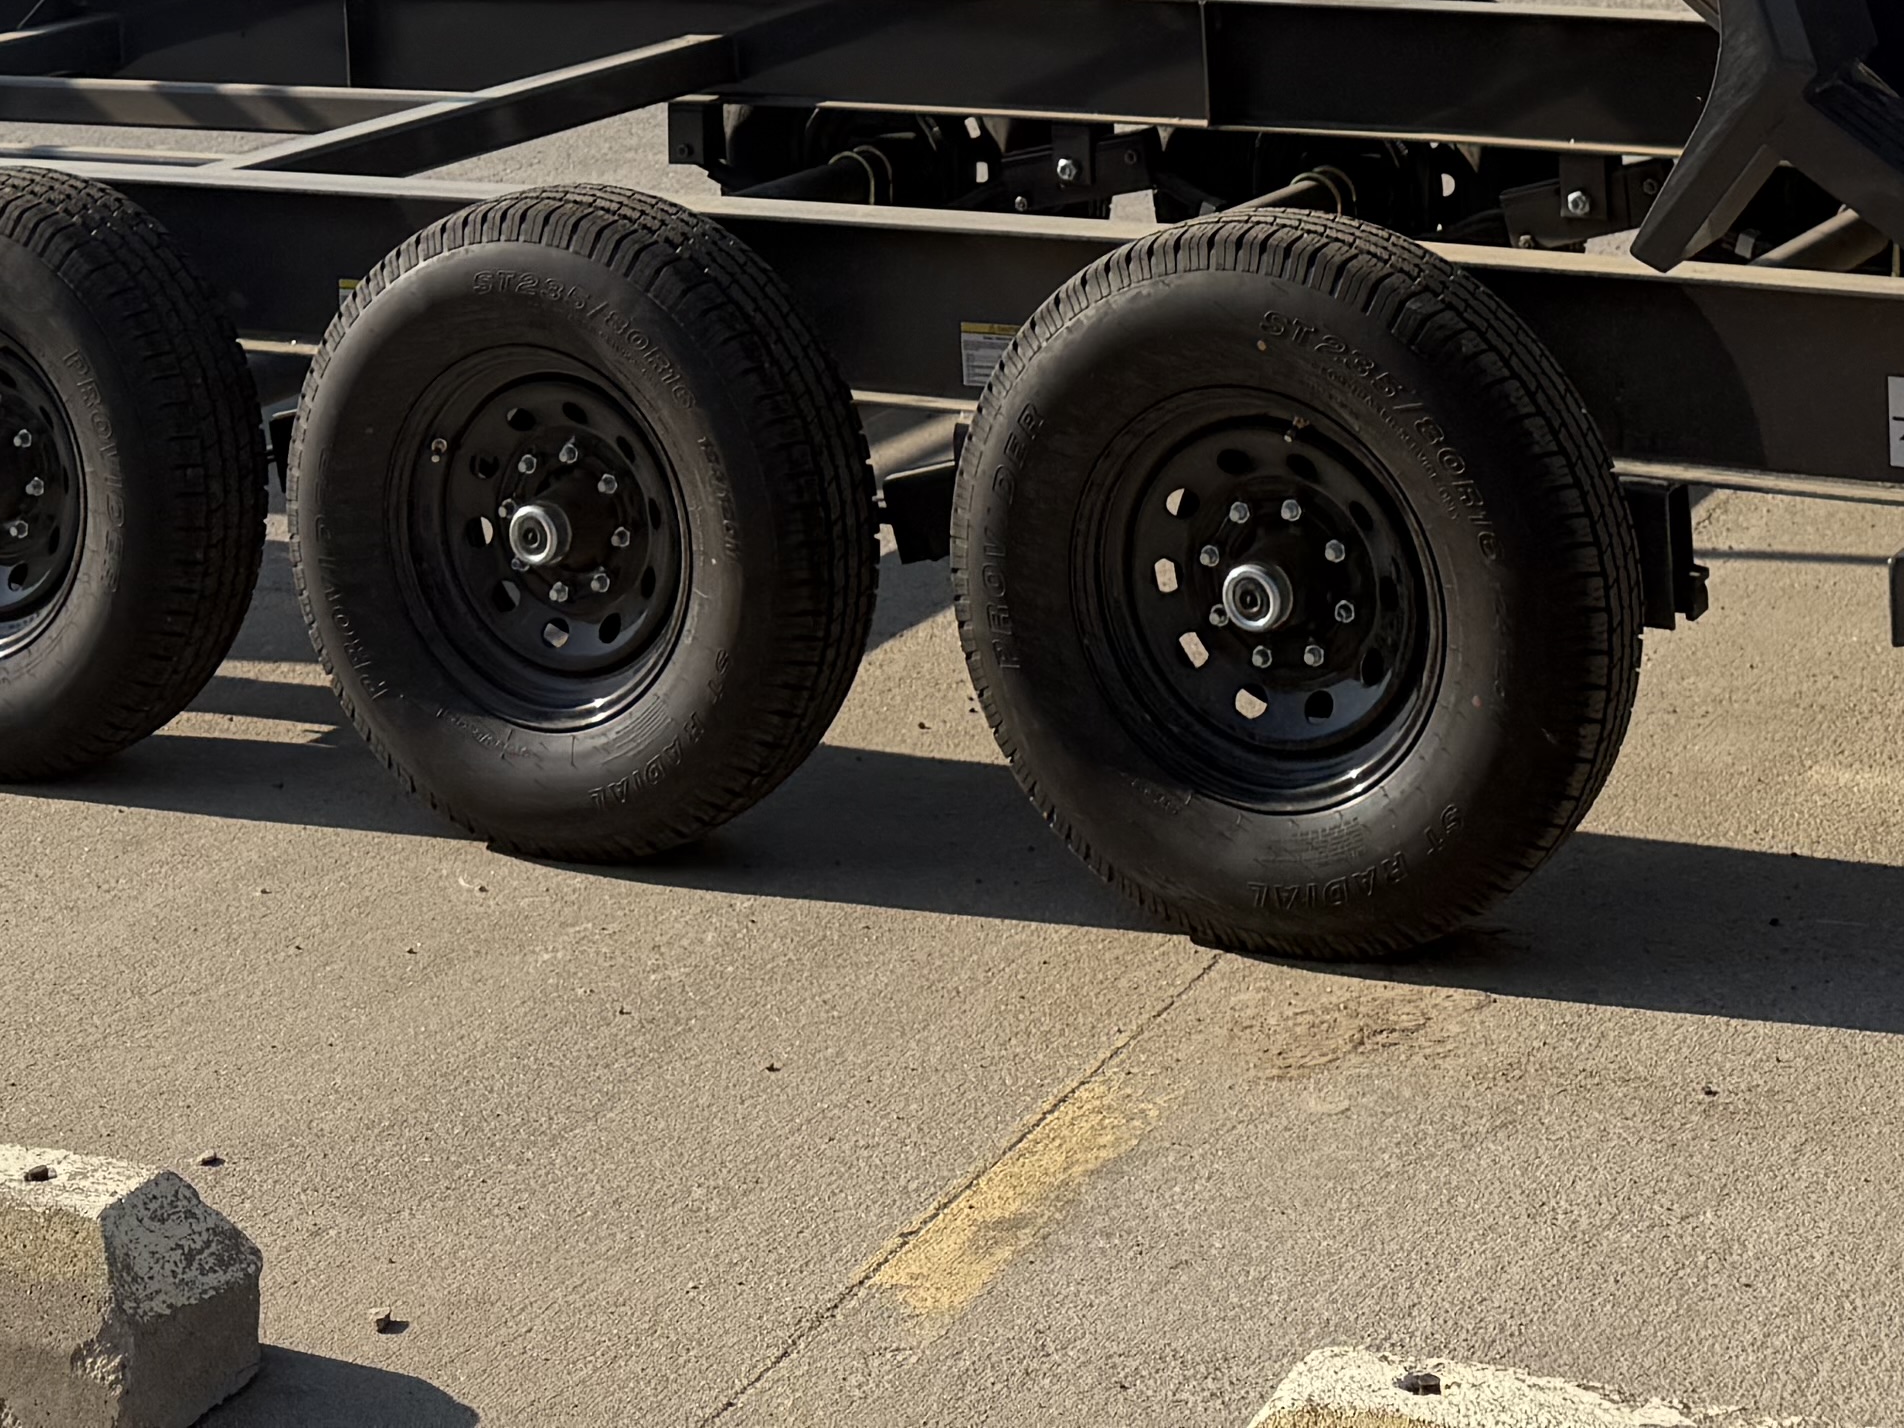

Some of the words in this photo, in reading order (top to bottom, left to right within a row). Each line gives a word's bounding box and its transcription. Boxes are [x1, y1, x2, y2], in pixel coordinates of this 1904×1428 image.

[472, 268, 697, 410] ST235/80R16
[1258, 309, 1502, 565] ST235/80R16
[981, 402, 1048, 670] PROVDER
[587, 710, 705, 810] RADIAL
[1247, 849, 1410, 911] RADIAL
[1423, 802, 1465, 856] ST
